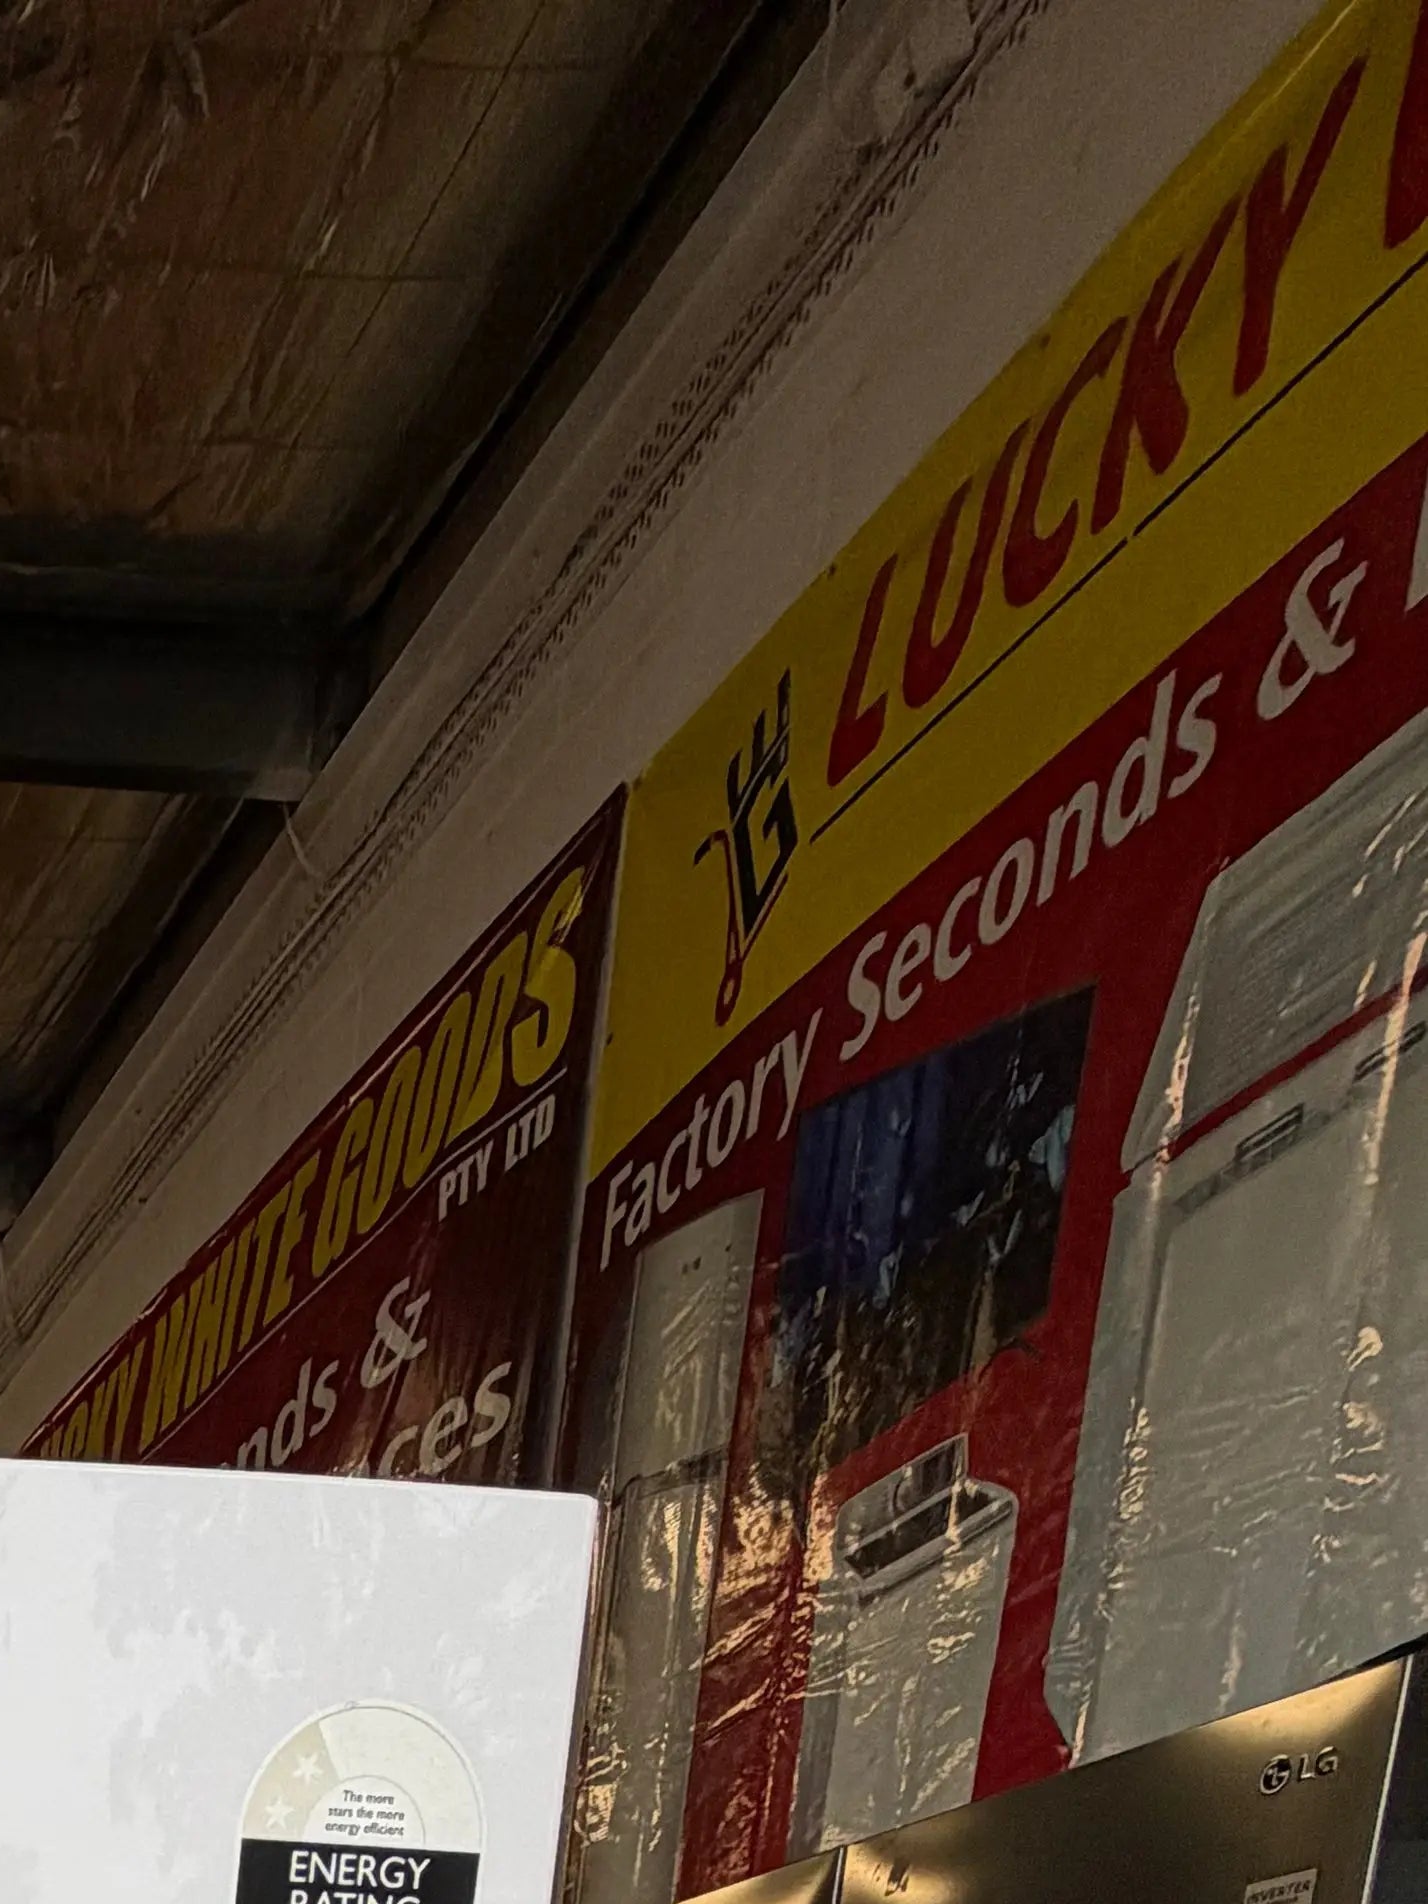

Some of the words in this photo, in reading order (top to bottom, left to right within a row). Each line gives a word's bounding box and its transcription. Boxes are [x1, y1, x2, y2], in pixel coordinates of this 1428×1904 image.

[827, 54, 1367, 787] LUCKY
[599, 1007, 824, 1271] Factory
[839, 669, 1223, 1064] Seconds
[1257, 538, 1367, 721] &
[140, 1150, 320, 1453] WHITE
[312, 866, 585, 1277] GOODS
[439, 1144, 491, 1222] PTY
[505, 1095, 556, 1168] LTD
[361, 1276, 432, 1388] &
[376, 1811, 405, 1821] more
[1297, 1745, 1339, 1782] LG
[288, 1850, 432, 1890] ENERGY
[325, 1823, 360, 1837] energy
[363, 1823, 405, 1836] efficient
